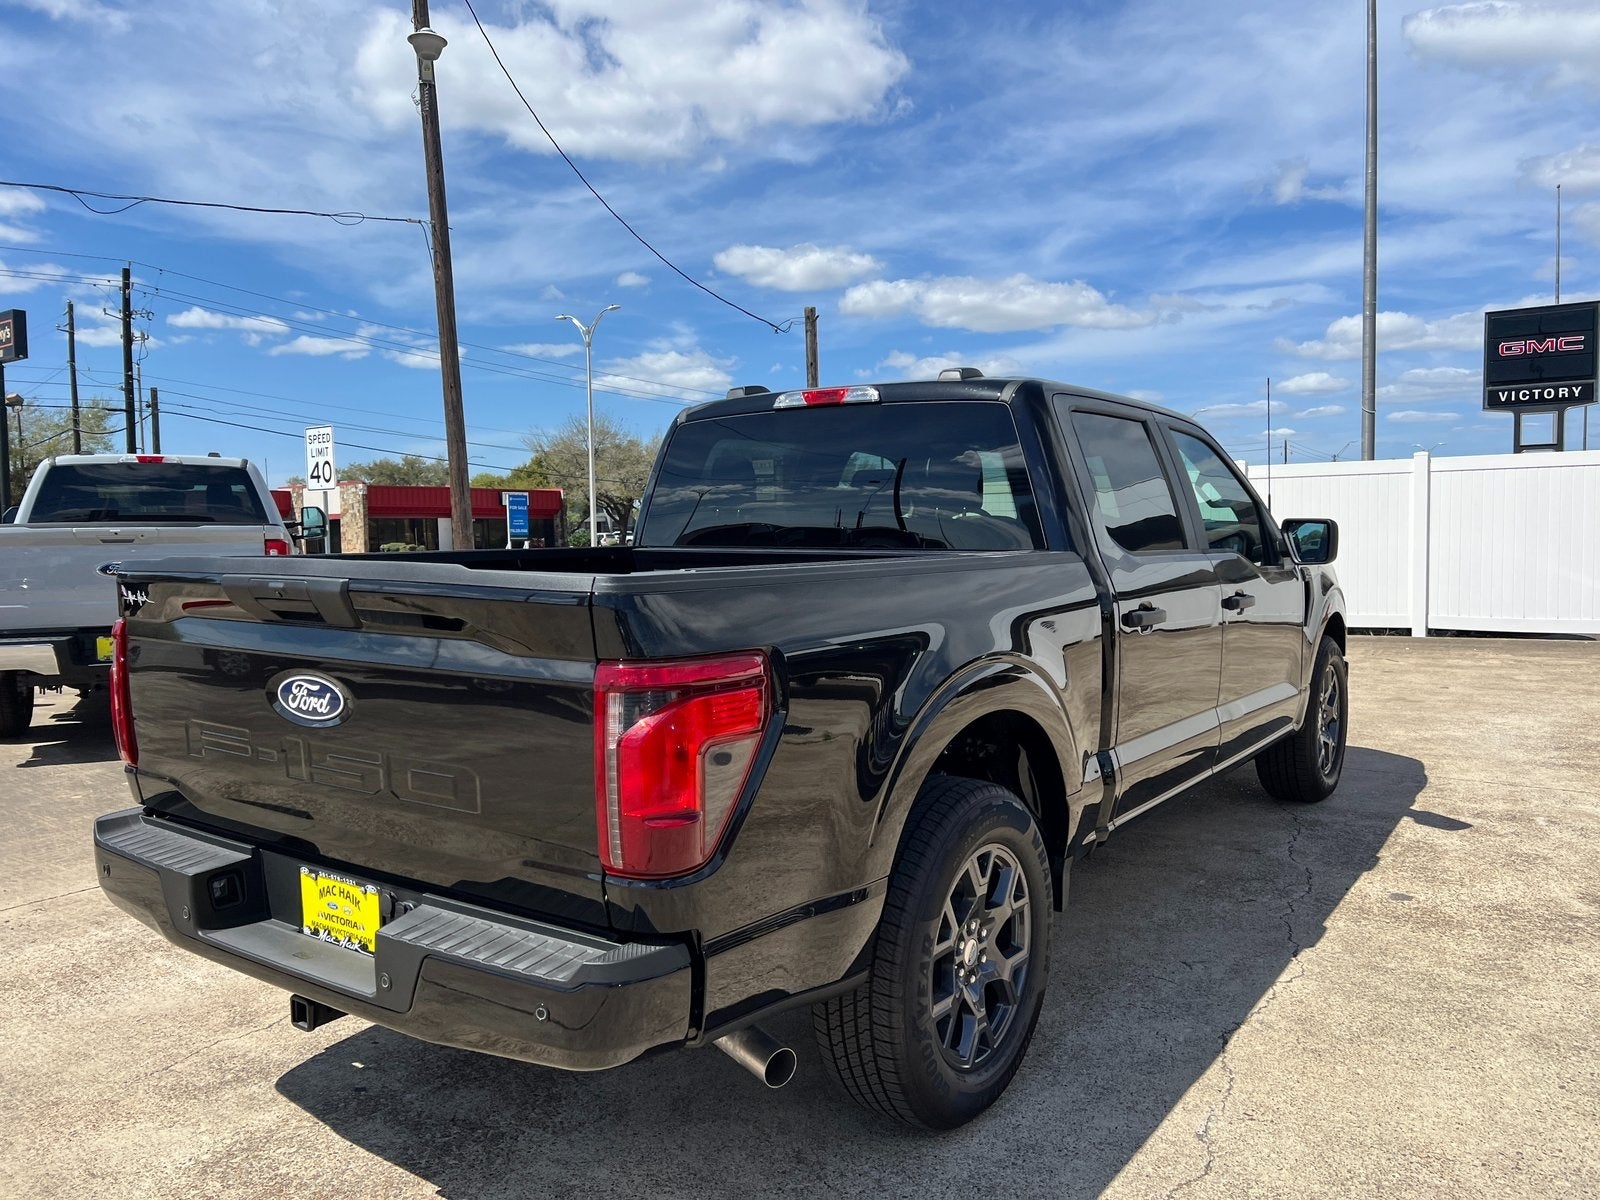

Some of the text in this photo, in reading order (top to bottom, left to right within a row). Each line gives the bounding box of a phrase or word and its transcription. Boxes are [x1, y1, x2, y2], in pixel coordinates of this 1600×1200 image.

[1498, 336, 1585, 357] GMC
[1498, 386, 1582, 402] VICTORY
[308, 432, 331, 445] SPEED
[310, 446, 329, 458] LIMIT
[309, 460, 332, 484] 40
[288, 681, 331, 714] Ford
[184, 718, 482, 814] F-150
[319, 885, 337, 900] MAC
[339, 886, 361, 912] HAIK
[323, 912, 359, 930] VICTORIA
[319, 929, 366, 953] Mac Haik
